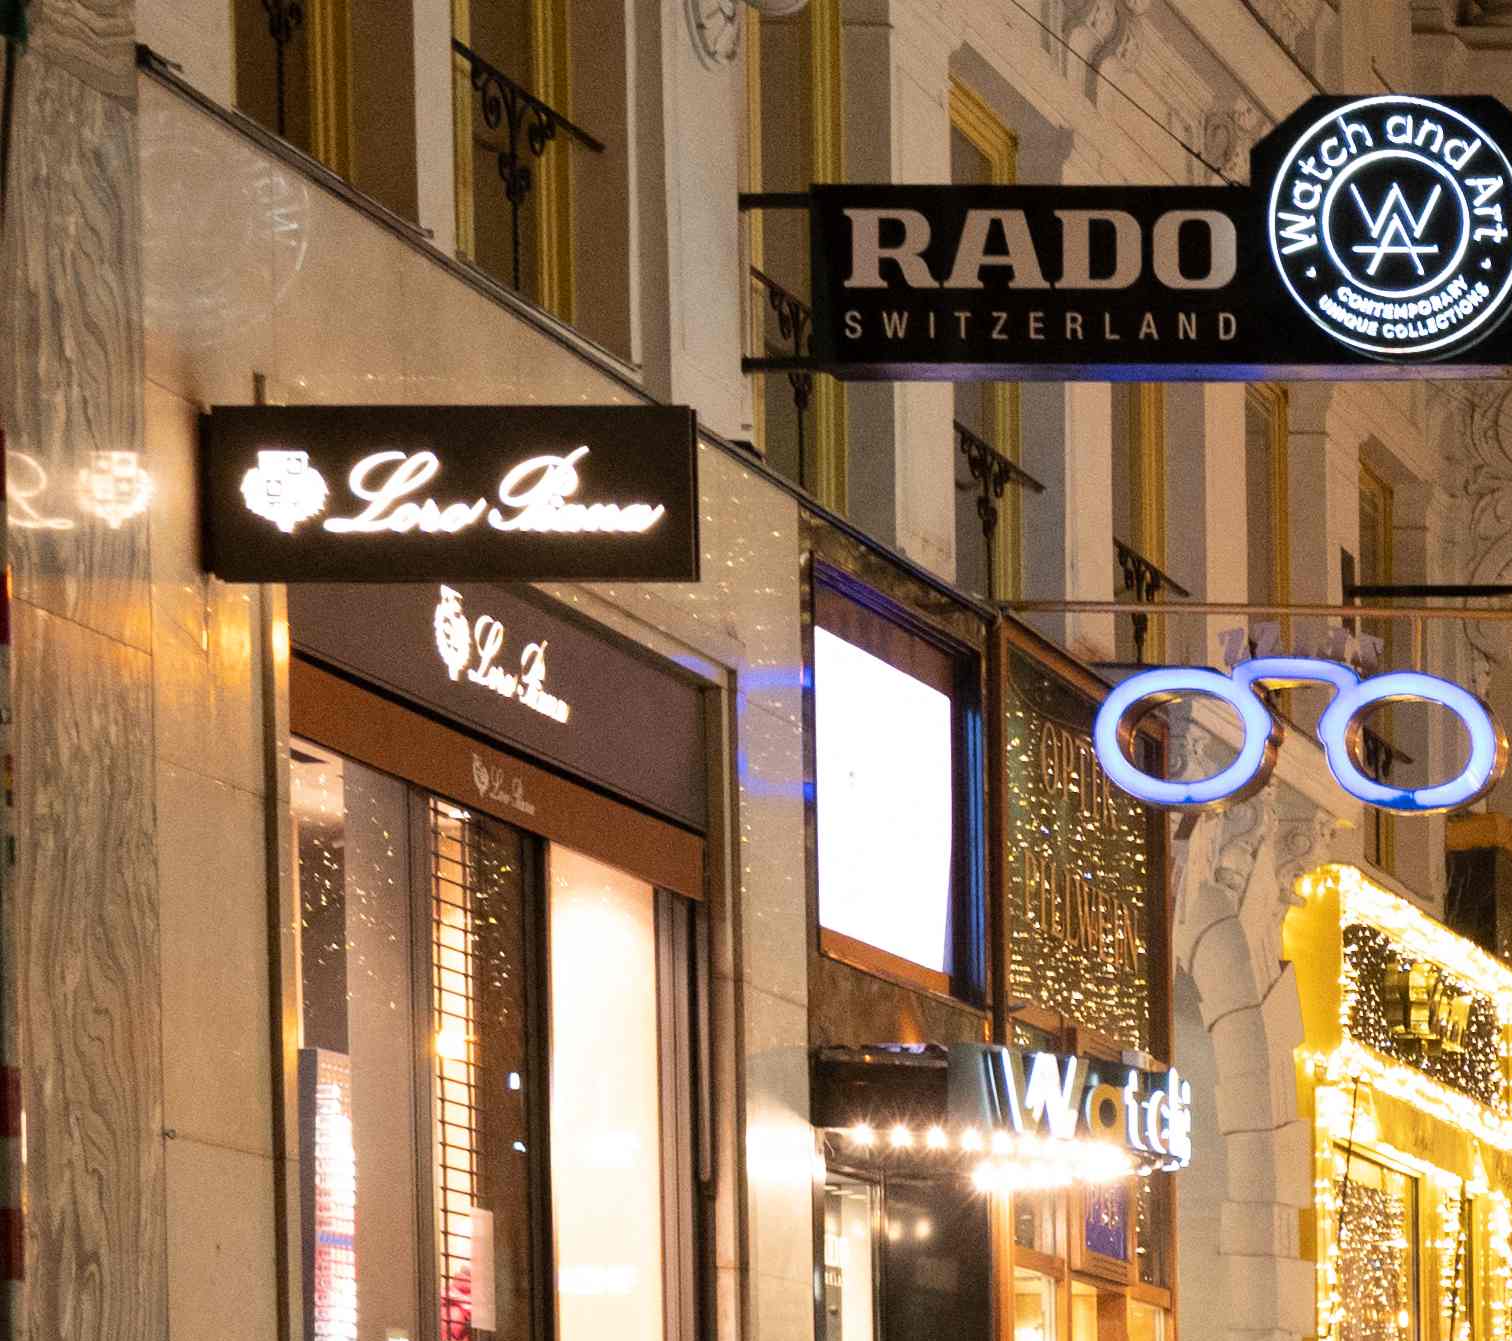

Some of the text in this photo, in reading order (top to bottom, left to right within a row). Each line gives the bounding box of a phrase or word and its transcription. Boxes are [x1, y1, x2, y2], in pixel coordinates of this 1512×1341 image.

[1278, 114, 1509, 255] Watch and Art
[843, 209, 1238, 289] RADO
[844, 311, 1238, 340] SWITZERLAND
[1319, 282, 1491, 339] UNIQUE COLLECTIONS
[1337, 274, 1469, 320] CONTEMPORARY
[323, 445, 666, 534] Loro Piana
